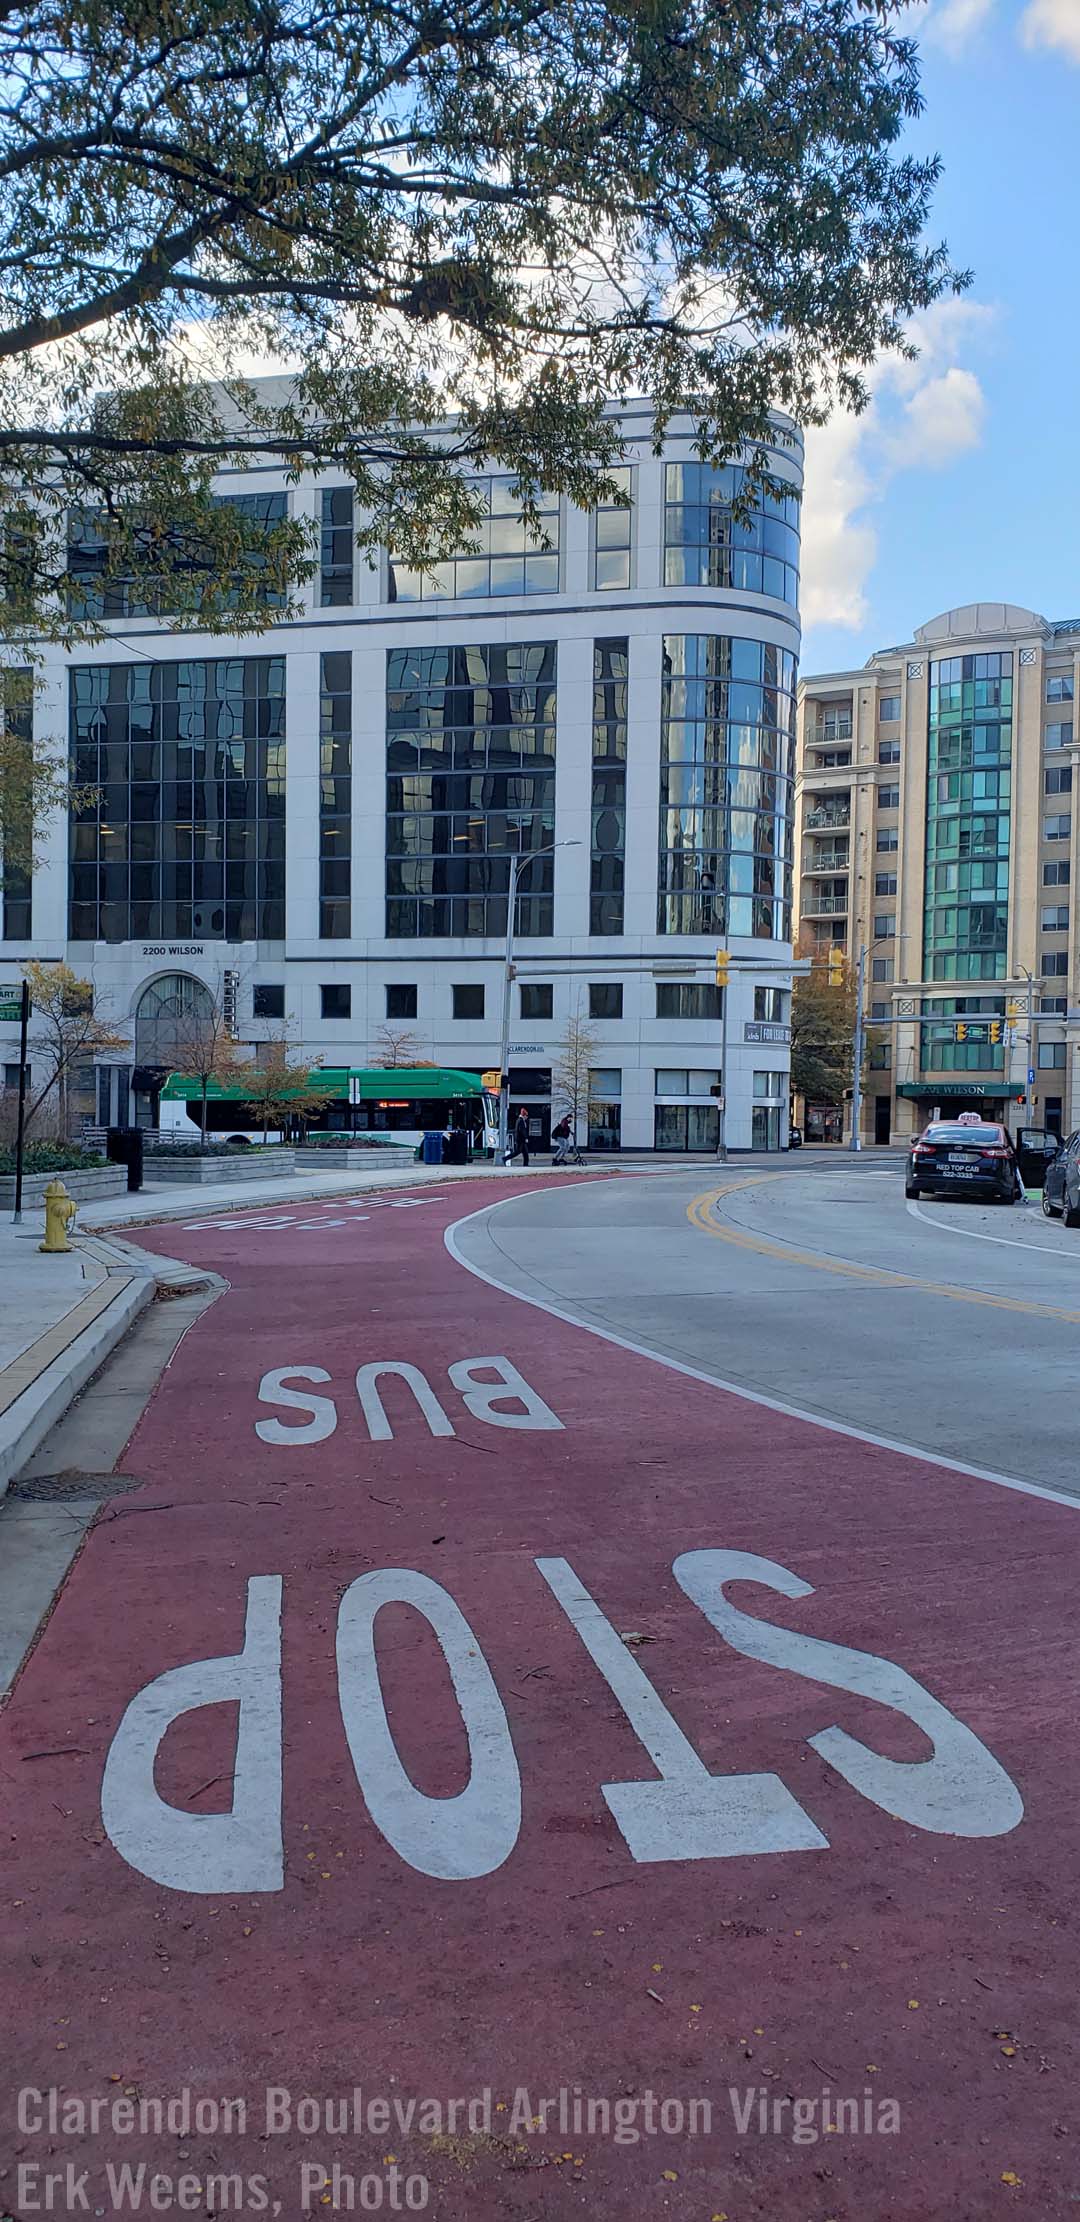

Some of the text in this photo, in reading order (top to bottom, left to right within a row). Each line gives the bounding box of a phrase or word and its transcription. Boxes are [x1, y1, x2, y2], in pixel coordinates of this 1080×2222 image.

[143, 946, 204, 955] 2200 WILSON
[763, 1028, 773, 1040] FOR
[943, 1086, 985, 1095] WILSON
[322, 1197, 448, 1207] BUS
[182, 1216, 370, 1230] STOP
[255, 1355, 565, 1445] BUS
[100, 1548, 1024, 1893] STOP
